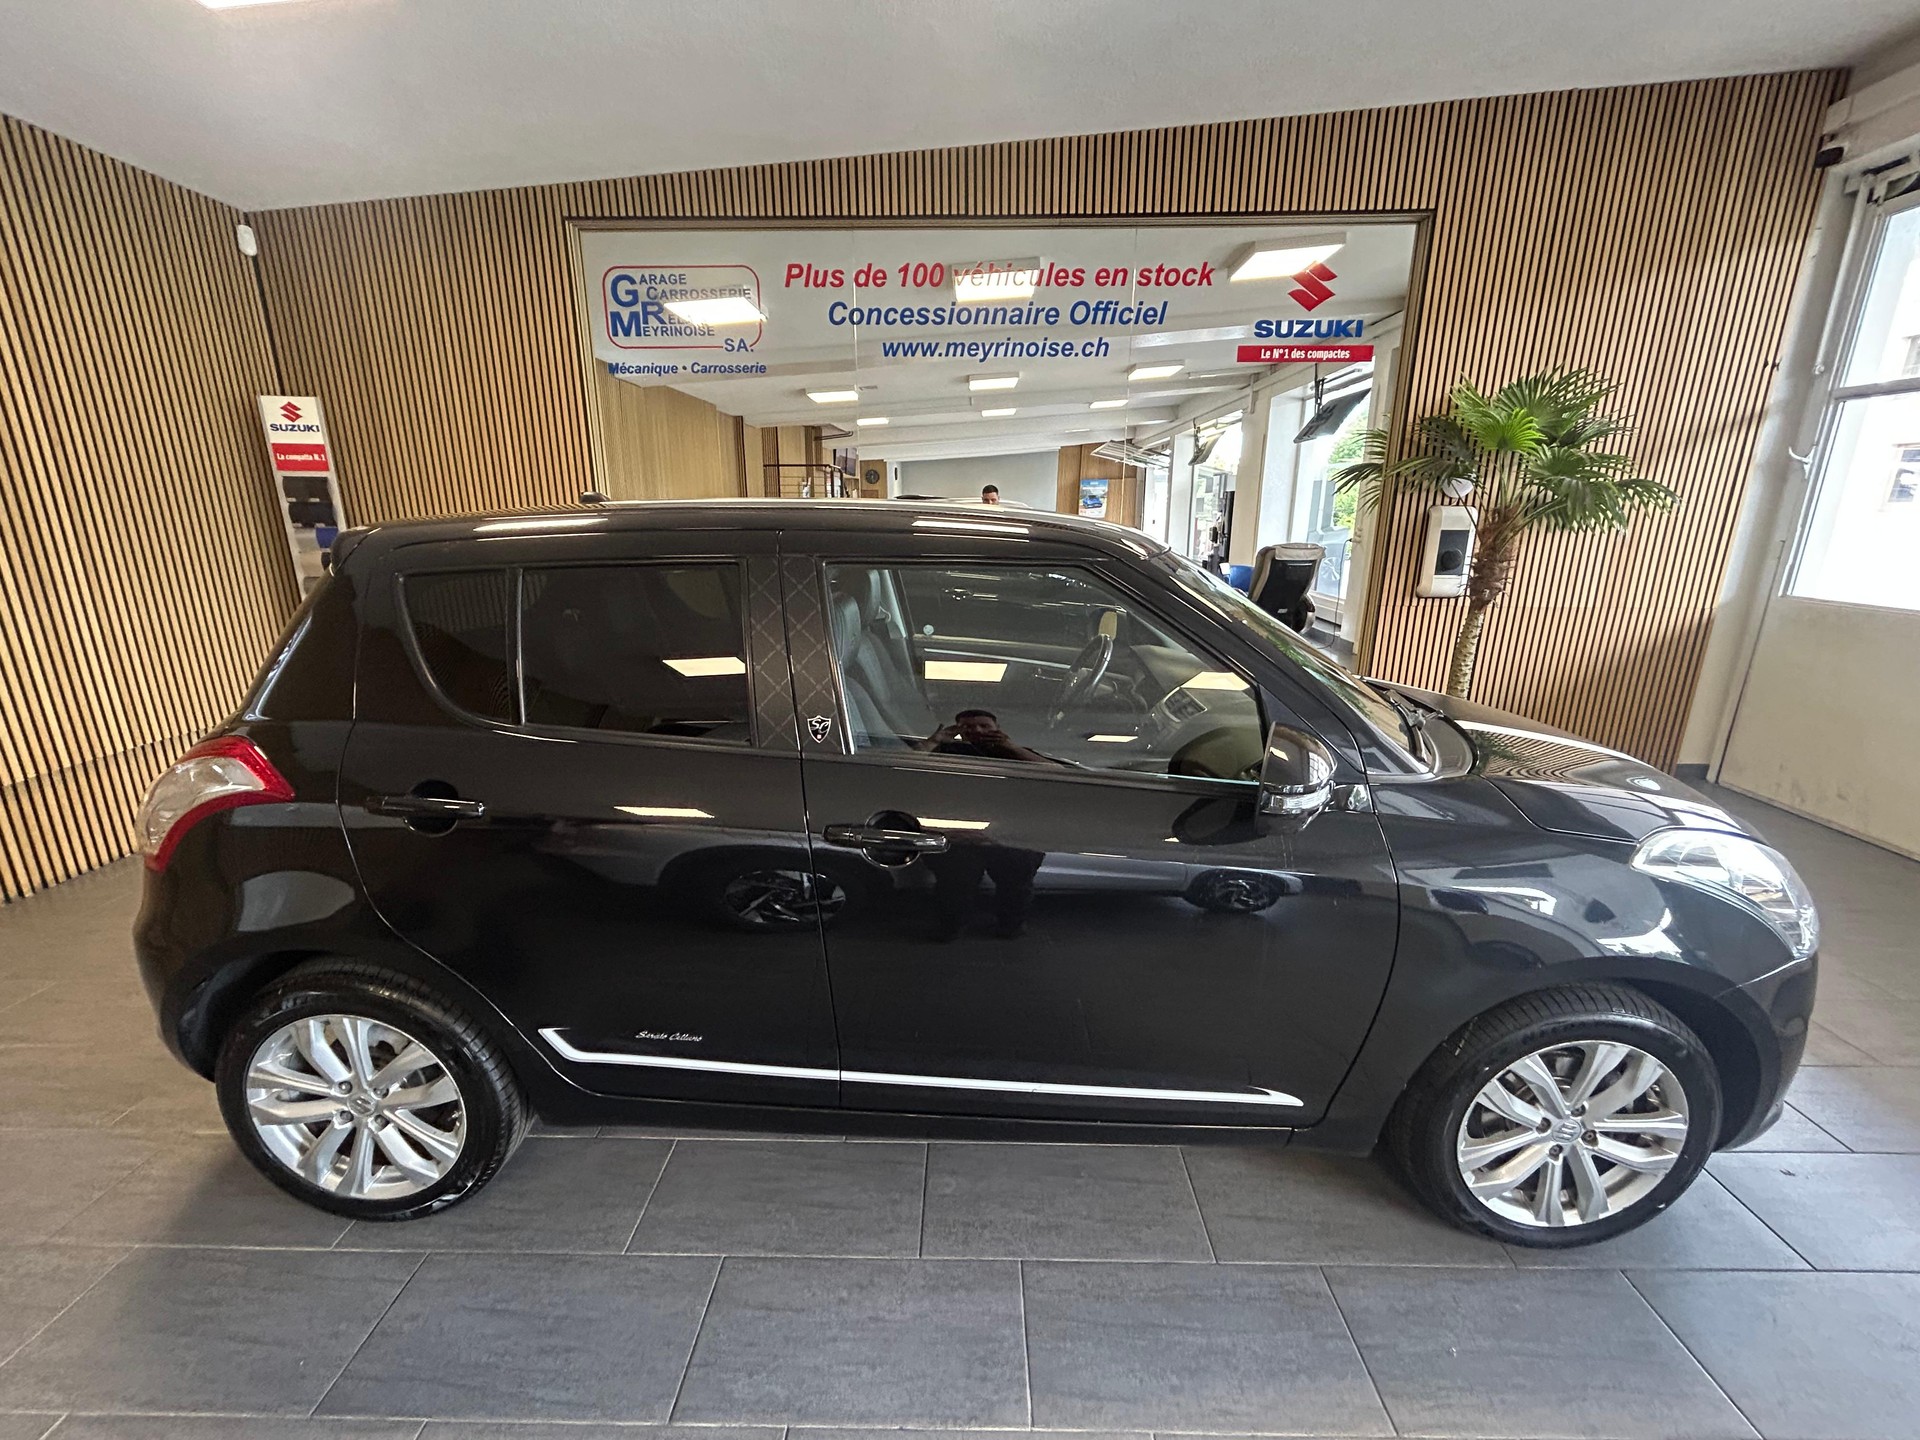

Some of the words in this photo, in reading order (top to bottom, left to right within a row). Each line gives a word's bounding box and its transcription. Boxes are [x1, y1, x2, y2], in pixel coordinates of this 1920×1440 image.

[785, 263, 845, 288] Plus
[854, 262, 887, 288] de
[898, 262, 945, 288] 100
[954, 261, 1085, 287] véhicules
[1094, 268, 1128, 287] en
[1137, 262, 1216, 287] stock
[610, 273, 688, 308] GARAGE
[609, 311, 715, 338] MEYRINOISE
[829, 301, 1060, 326] Concessionnaire
[1069, 300, 1169, 325] Officiel
[1253, 319, 1364, 338] SUZUKI
[882, 337, 1110, 363] www.meyrinoise.ch
[1260, 348, 1271, 359] Le
[1291, 348, 1305, 359] des
[1307, 349, 1351, 361] compactes
[608, 362, 679, 377] Mécanique
[690, 361, 767, 374] Carrosserie
[269, 423, 320, 433] SUZUKI
